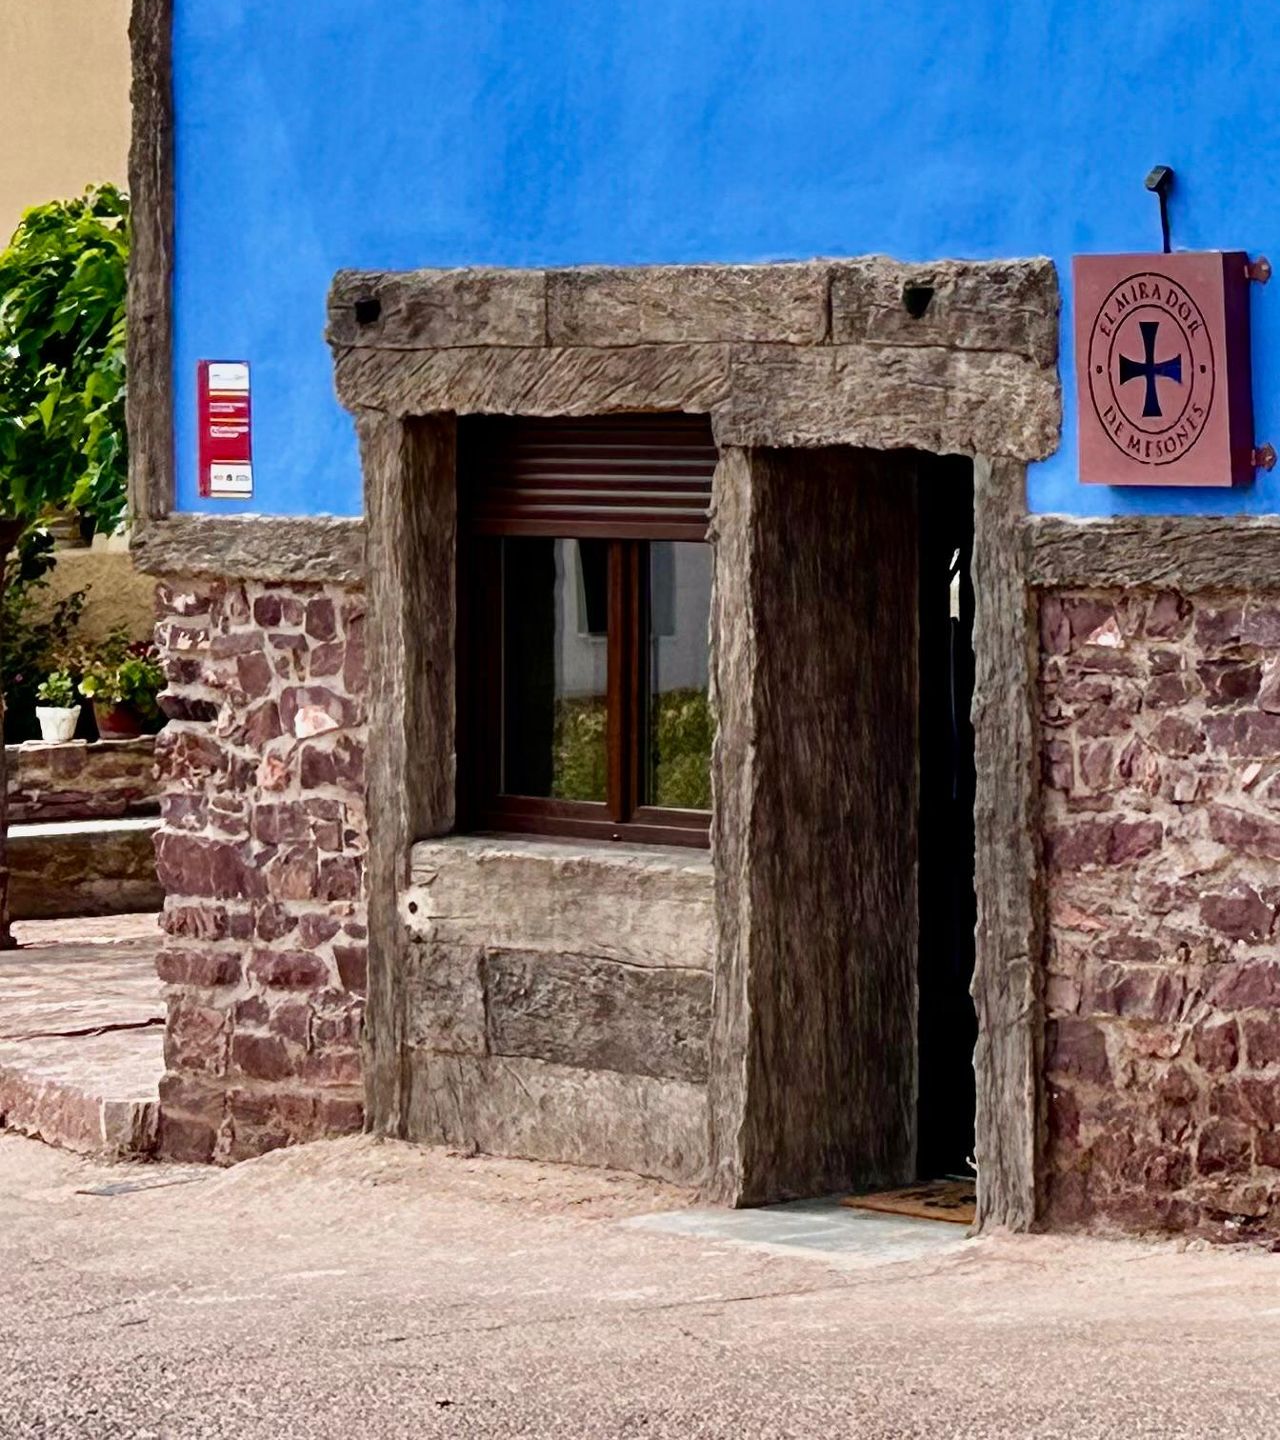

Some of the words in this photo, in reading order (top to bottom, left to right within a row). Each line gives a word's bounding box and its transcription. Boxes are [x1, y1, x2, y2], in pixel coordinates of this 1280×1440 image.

[1100, 311, 1117, 338] EL
[1115, 281, 1203, 339] MIRADOR
[1103, 404, 1125, 438] DE
[1126, 402, 1205, 458] MESONES
